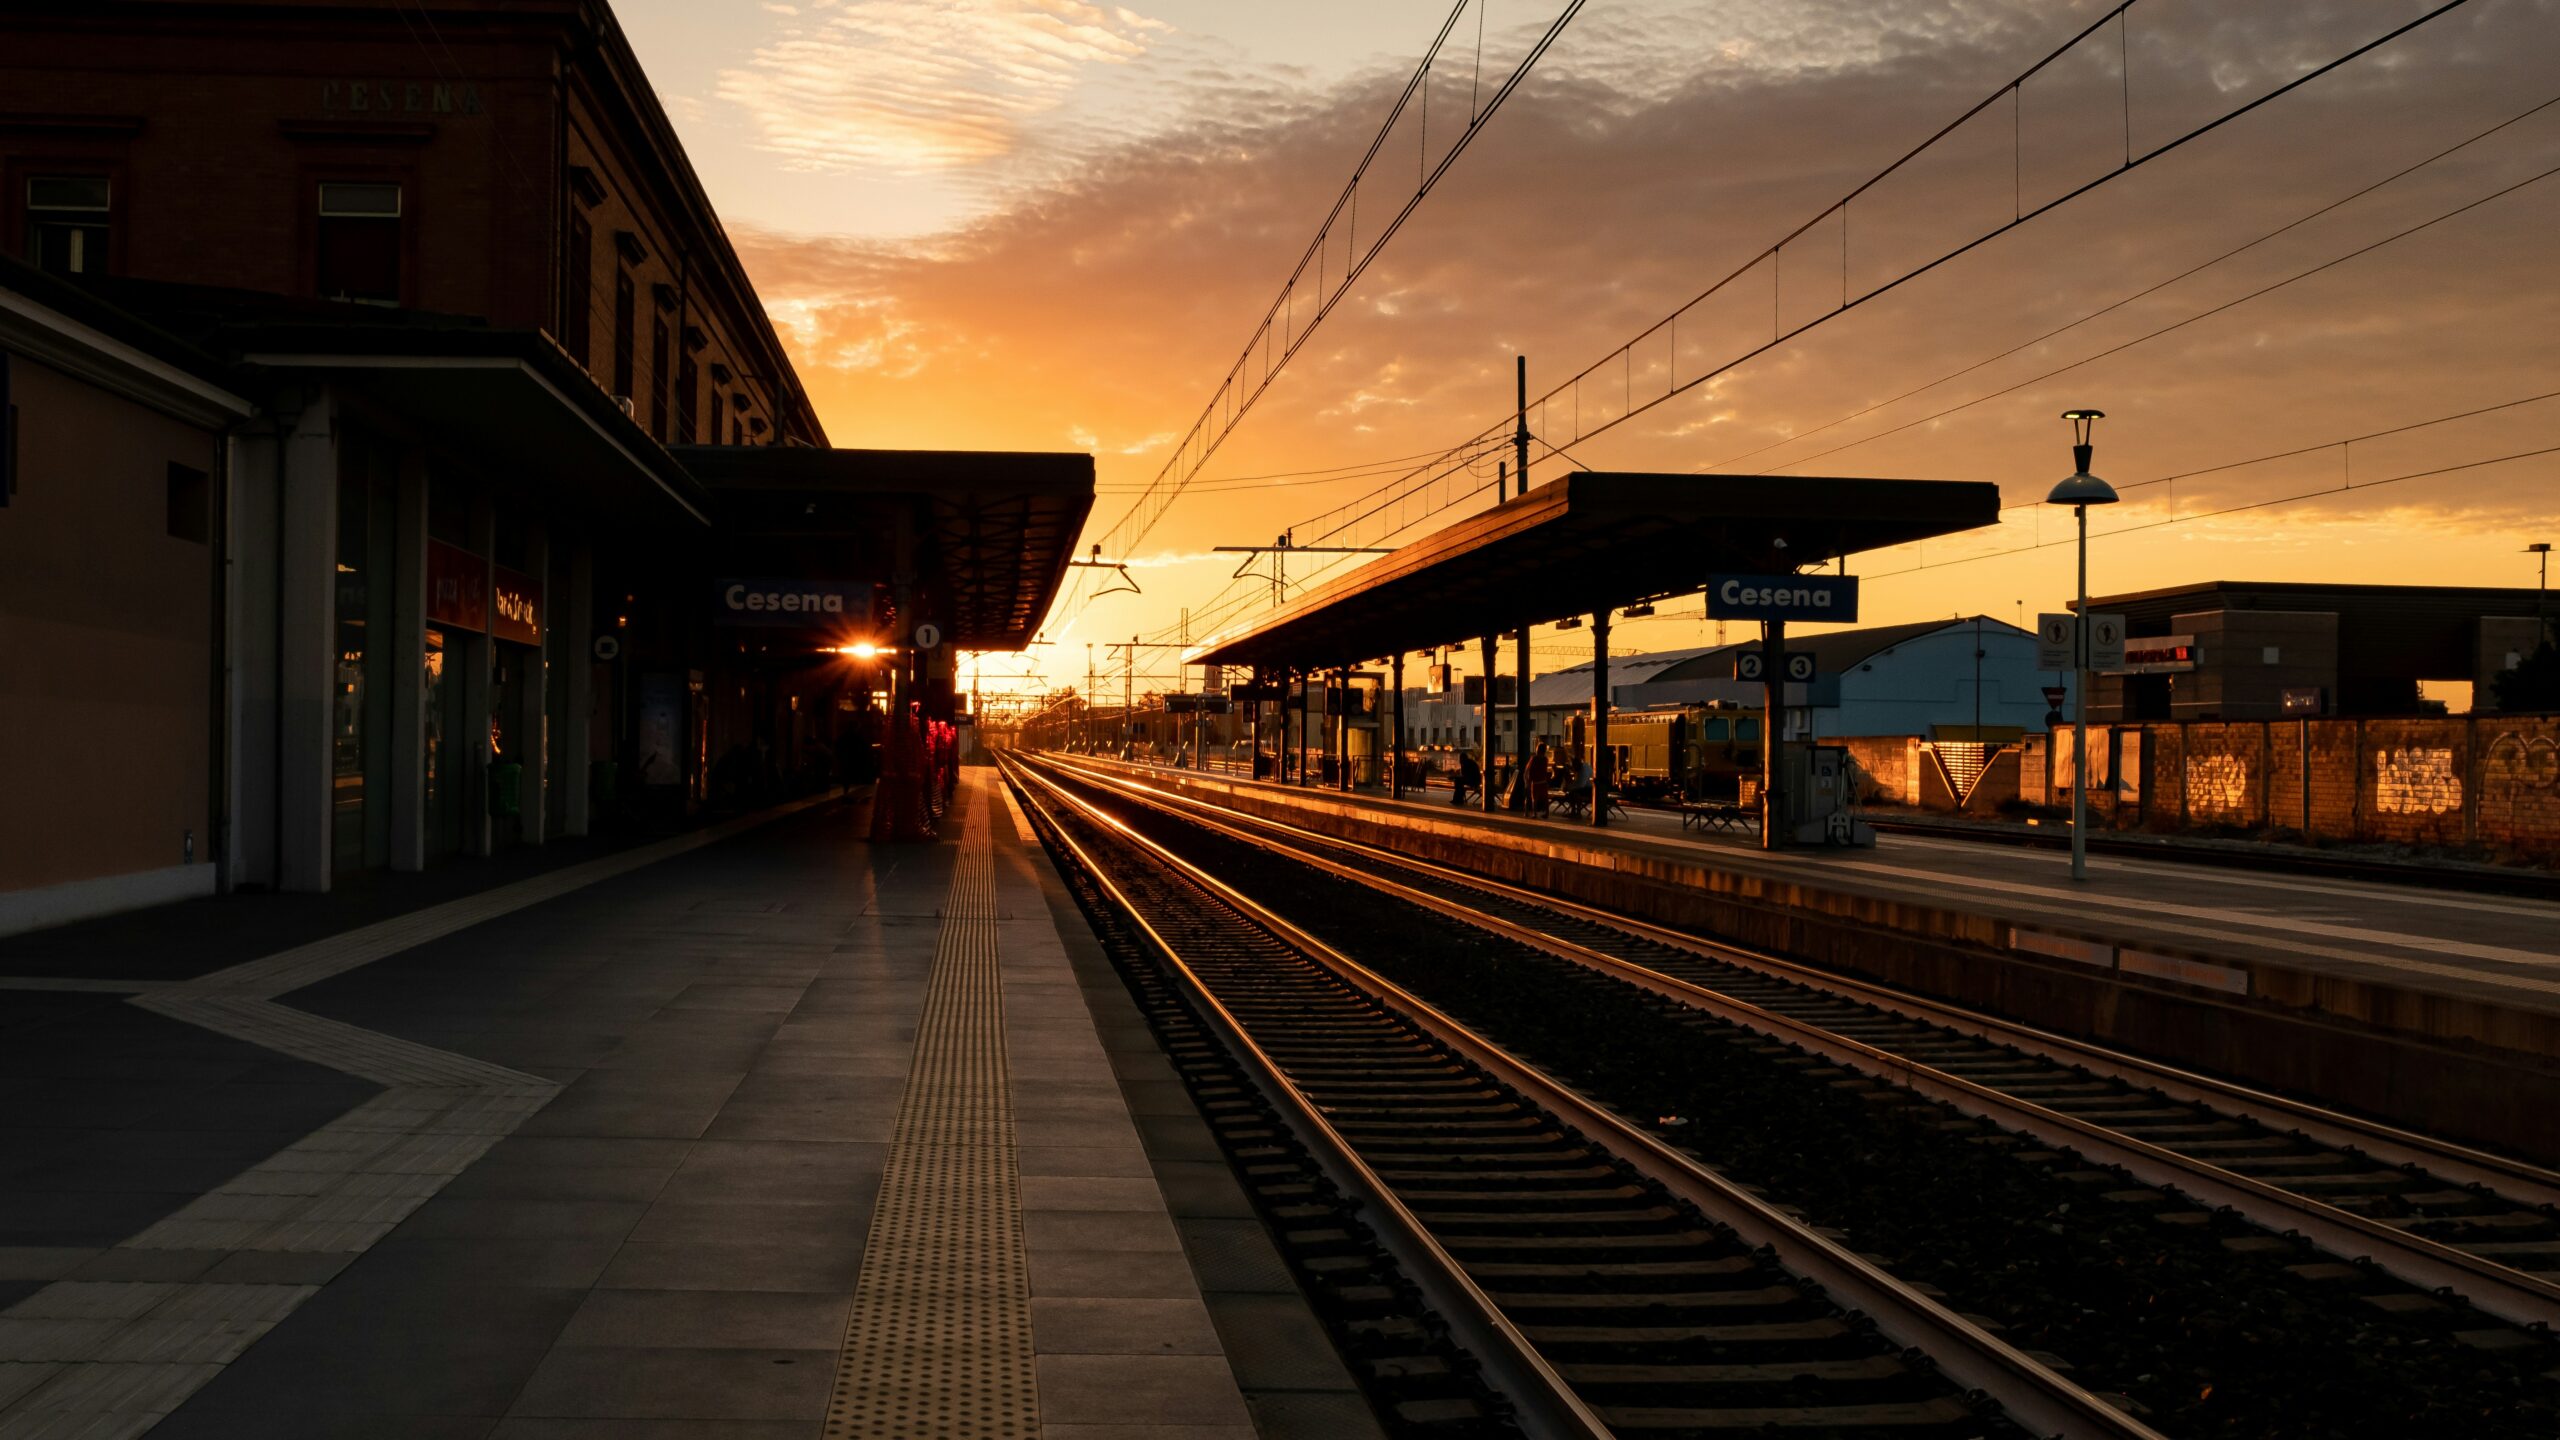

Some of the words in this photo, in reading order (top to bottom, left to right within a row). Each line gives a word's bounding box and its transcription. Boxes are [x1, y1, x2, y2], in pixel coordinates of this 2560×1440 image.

[322, 80, 481, 115] CESENA
[725, 584, 843, 613] Cesena
[1720, 579, 1832, 608] Cesena
[1744, 658, 1756, 674] 2
[1794, 659, 1806, 675] 3
